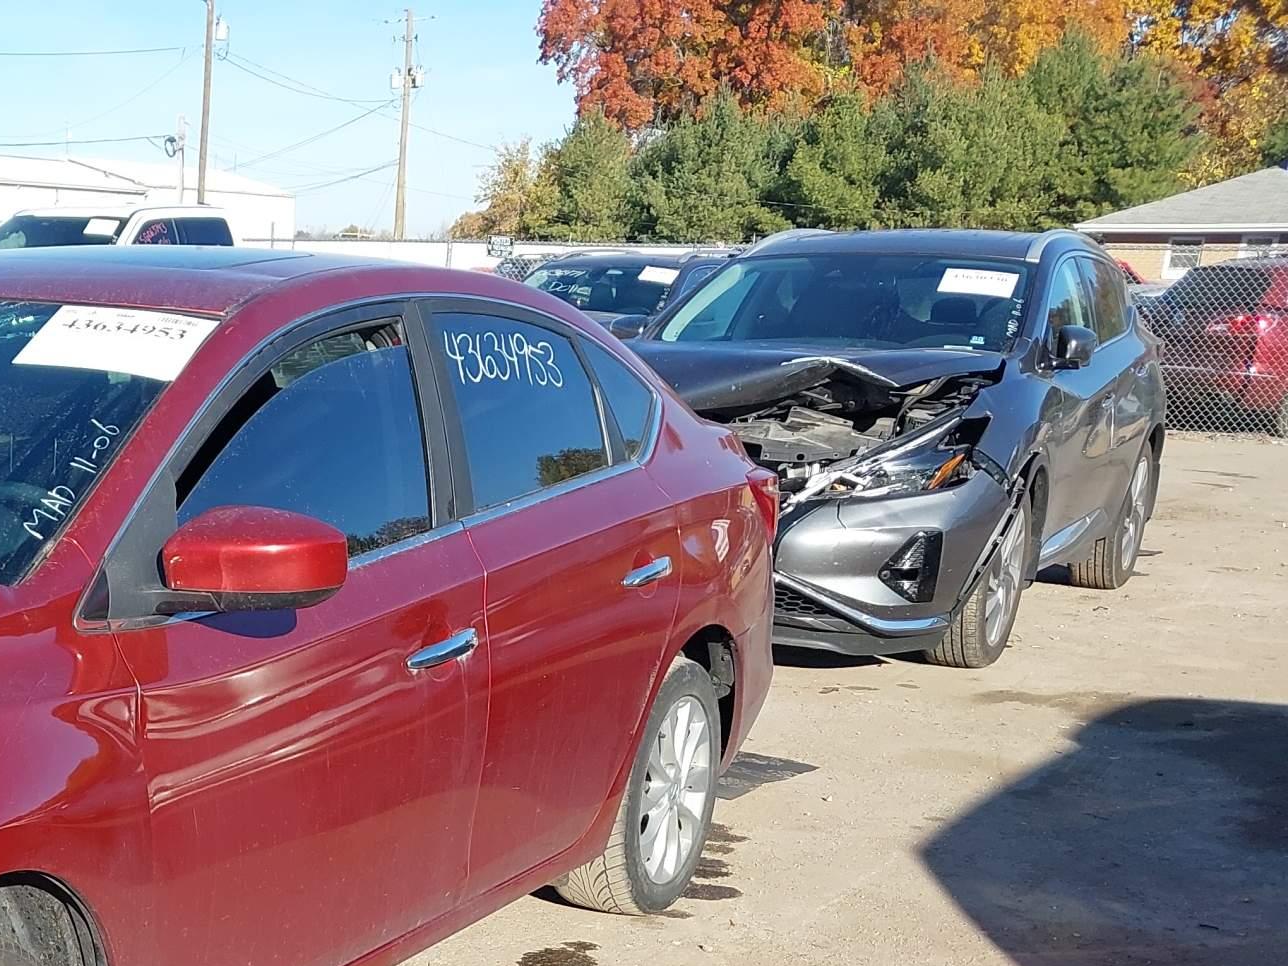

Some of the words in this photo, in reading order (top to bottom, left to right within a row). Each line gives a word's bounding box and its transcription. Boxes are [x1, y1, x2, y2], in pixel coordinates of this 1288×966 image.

[62, 317, 188, 340] 43634953
[443, 330, 563, 388] 43634953
[23, 485, 76, 540] MAD
[70, 418, 120, 474] 11-06
